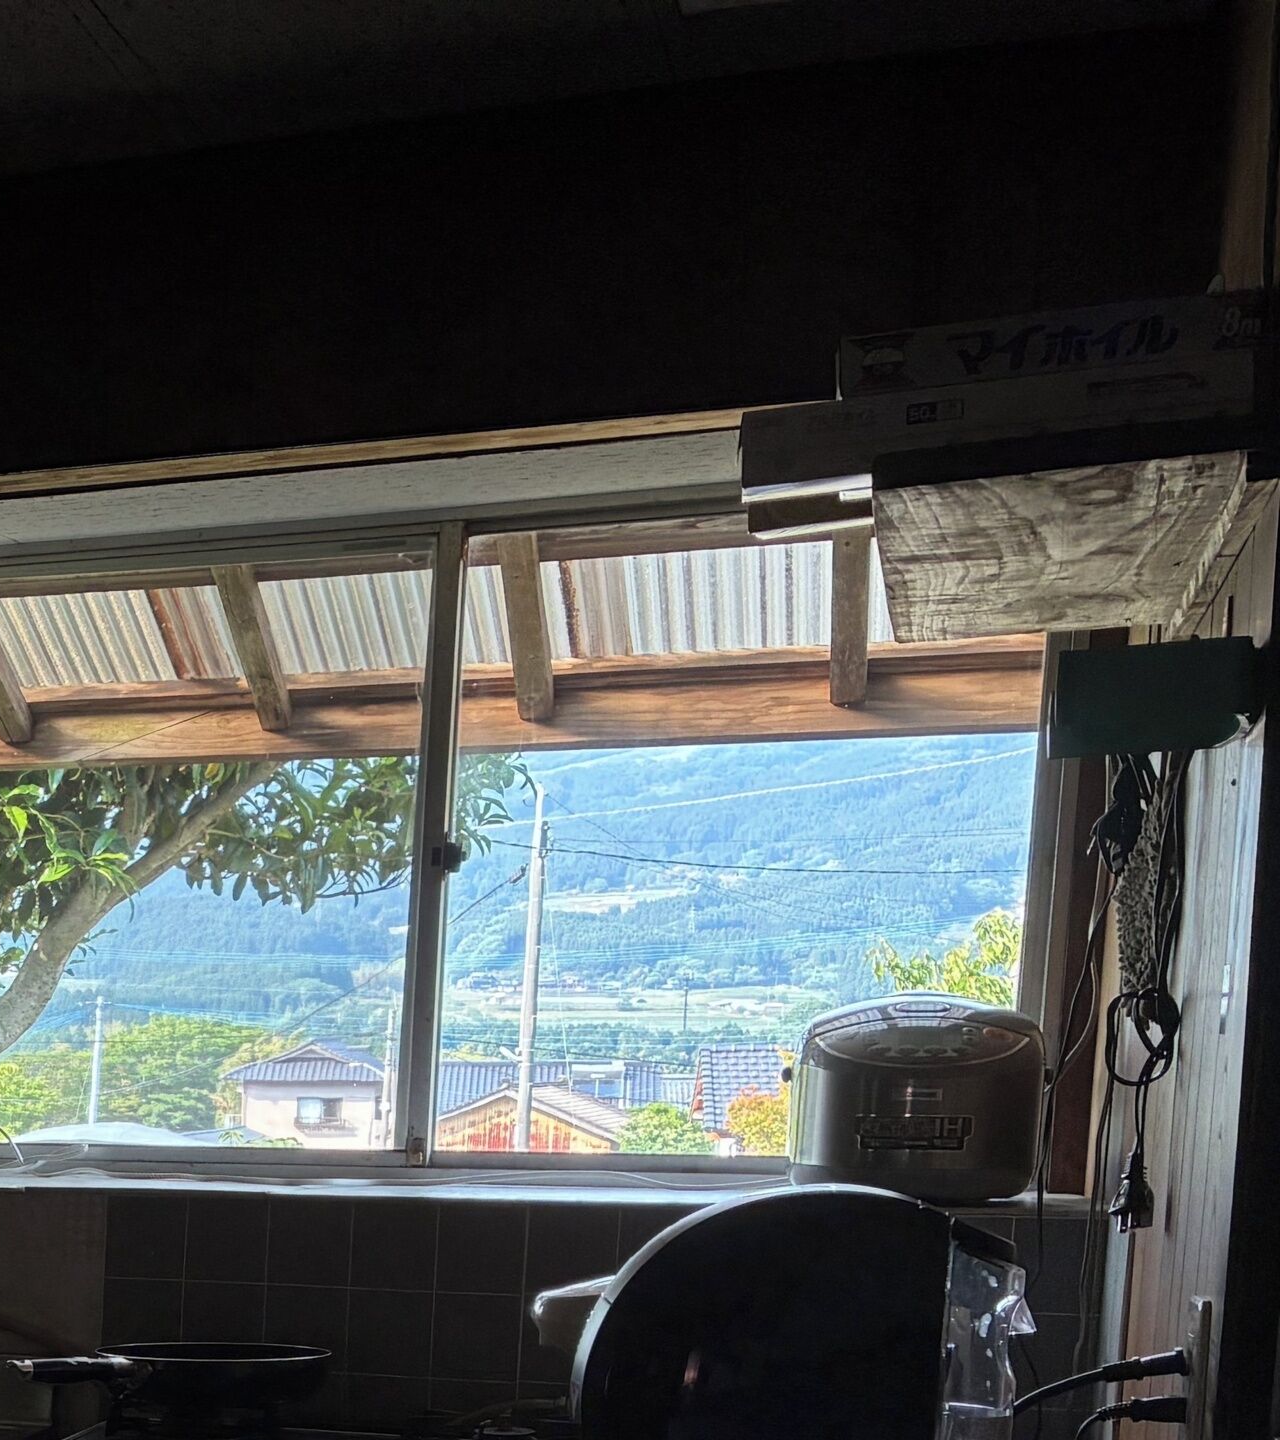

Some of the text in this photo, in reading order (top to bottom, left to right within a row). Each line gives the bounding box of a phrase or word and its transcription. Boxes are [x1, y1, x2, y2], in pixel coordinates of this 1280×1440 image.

[947, 315, 1178, 375] マイホイル
